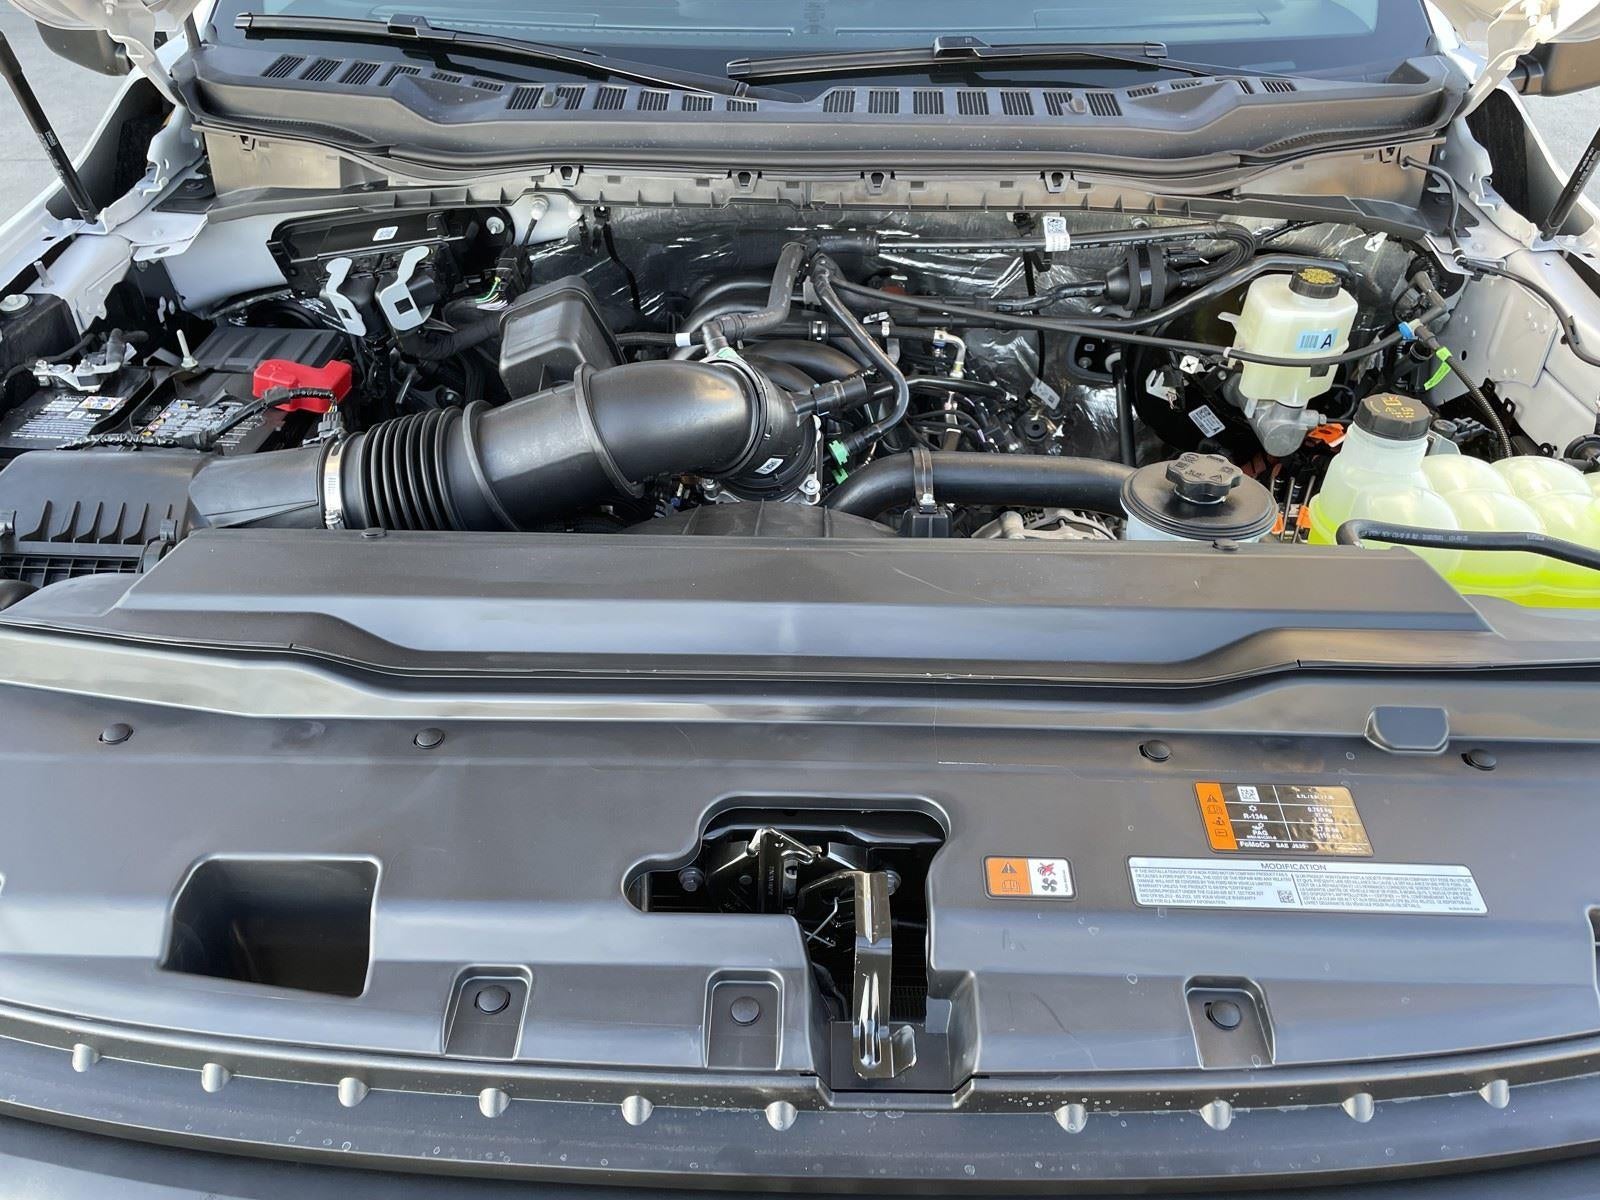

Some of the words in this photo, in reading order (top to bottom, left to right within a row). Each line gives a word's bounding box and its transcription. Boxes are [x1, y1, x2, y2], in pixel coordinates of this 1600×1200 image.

[1320, 333, 1332, 349] A
[1239, 840, 1271, 848] FoMoCo
[1260, 862, 1327, 871] MODIFICATION
